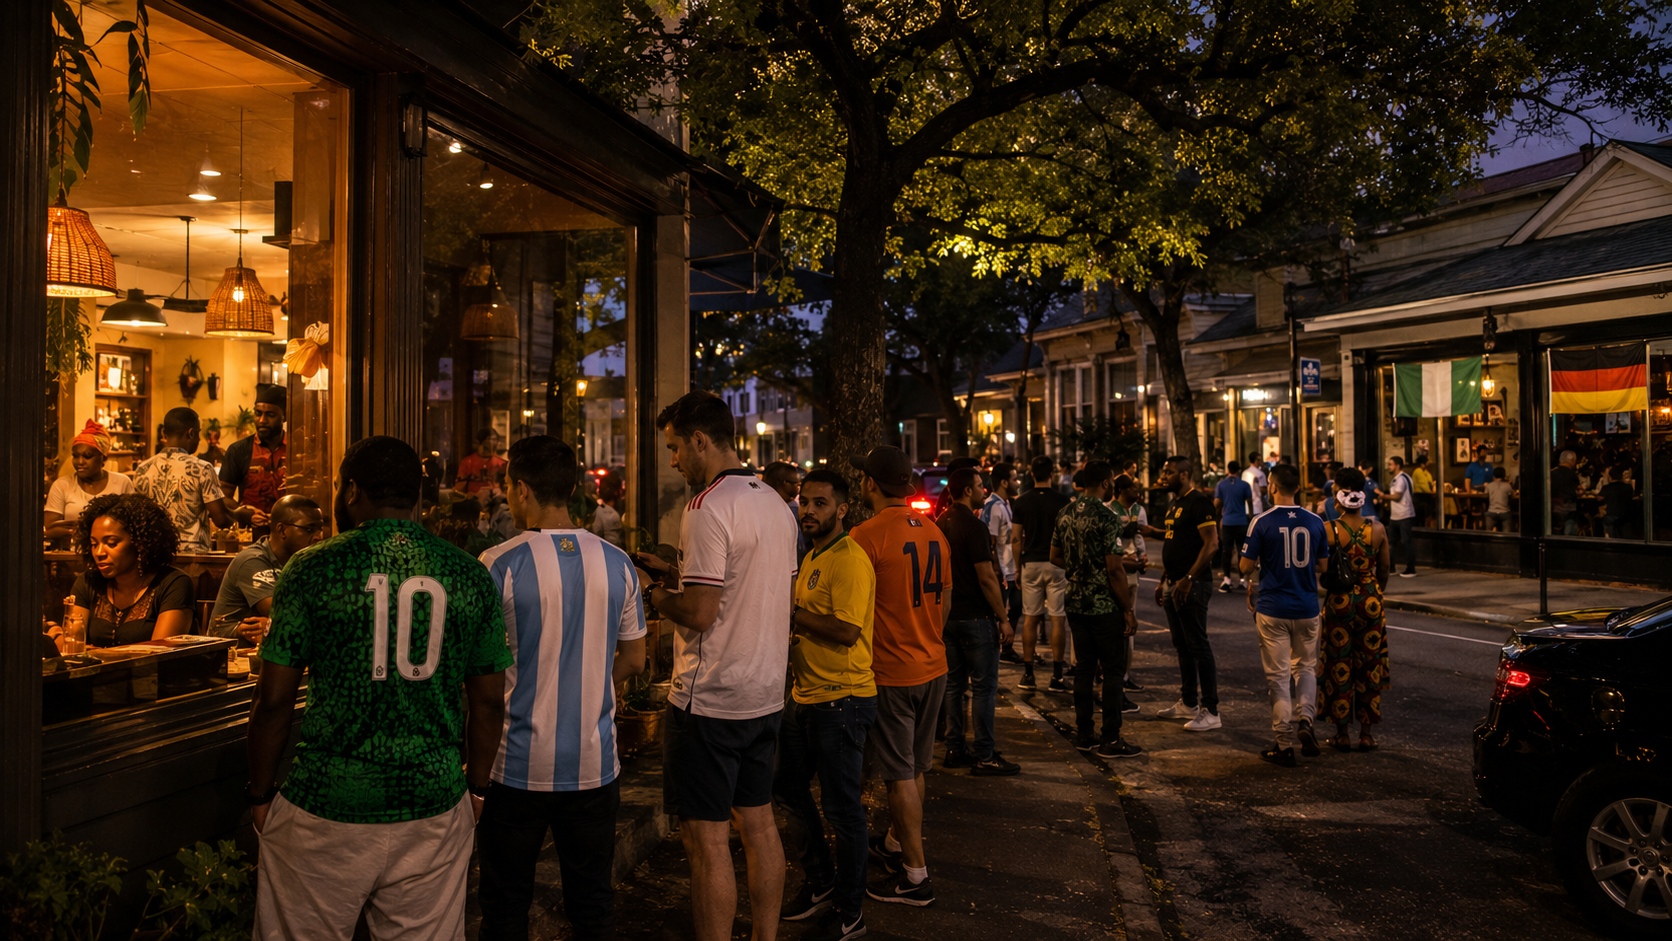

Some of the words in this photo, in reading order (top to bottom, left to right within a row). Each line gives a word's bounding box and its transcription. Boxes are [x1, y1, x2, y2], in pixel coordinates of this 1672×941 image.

[902, 541, 943, 607] 14
[1279, 526, 1311, 569] 10
[364, 573, 448, 681] 10
